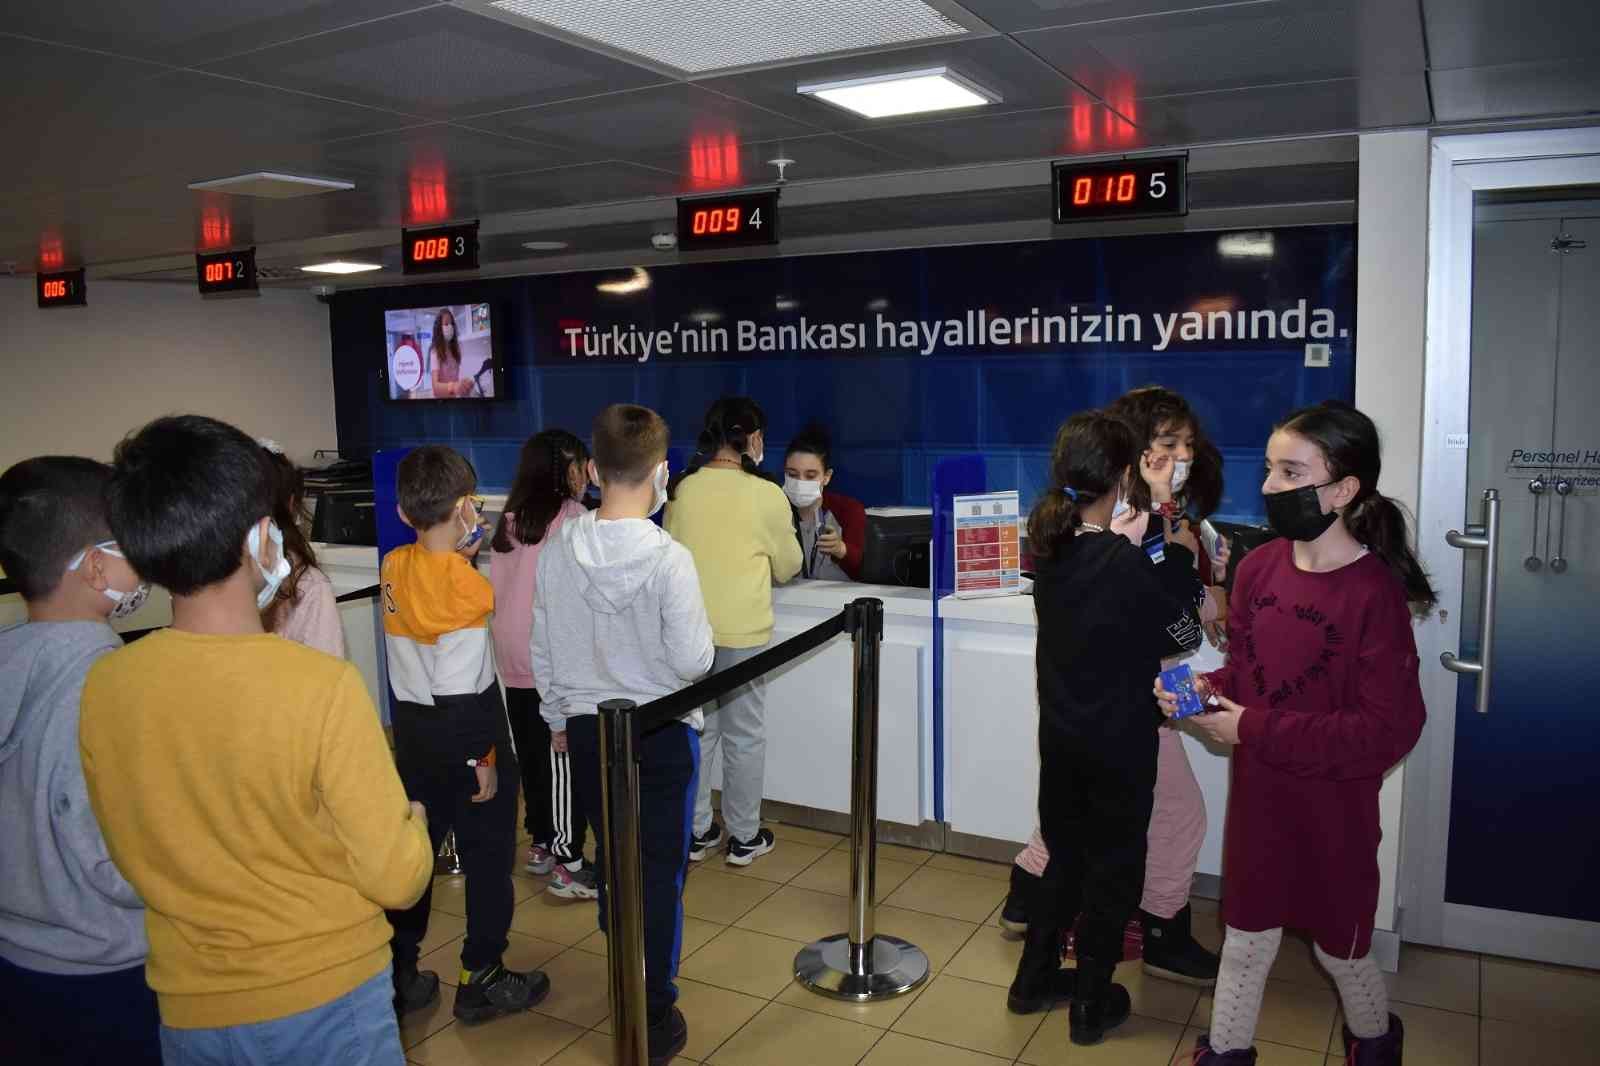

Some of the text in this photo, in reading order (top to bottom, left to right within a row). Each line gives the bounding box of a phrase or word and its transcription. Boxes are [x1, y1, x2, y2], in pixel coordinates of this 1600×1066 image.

[1074, 172, 1167, 205] 010 5
[693, 207, 762, 235] 009 4
[413, 236, 465, 261] 008 3
[205, 261, 245, 281] 007 2
[44, 280, 66, 298] 006
[564, 298, 1349, 363] Türkiye'nin Bankası hayallerinizin yanında.
[1510, 449, 1581, 464] Personel
